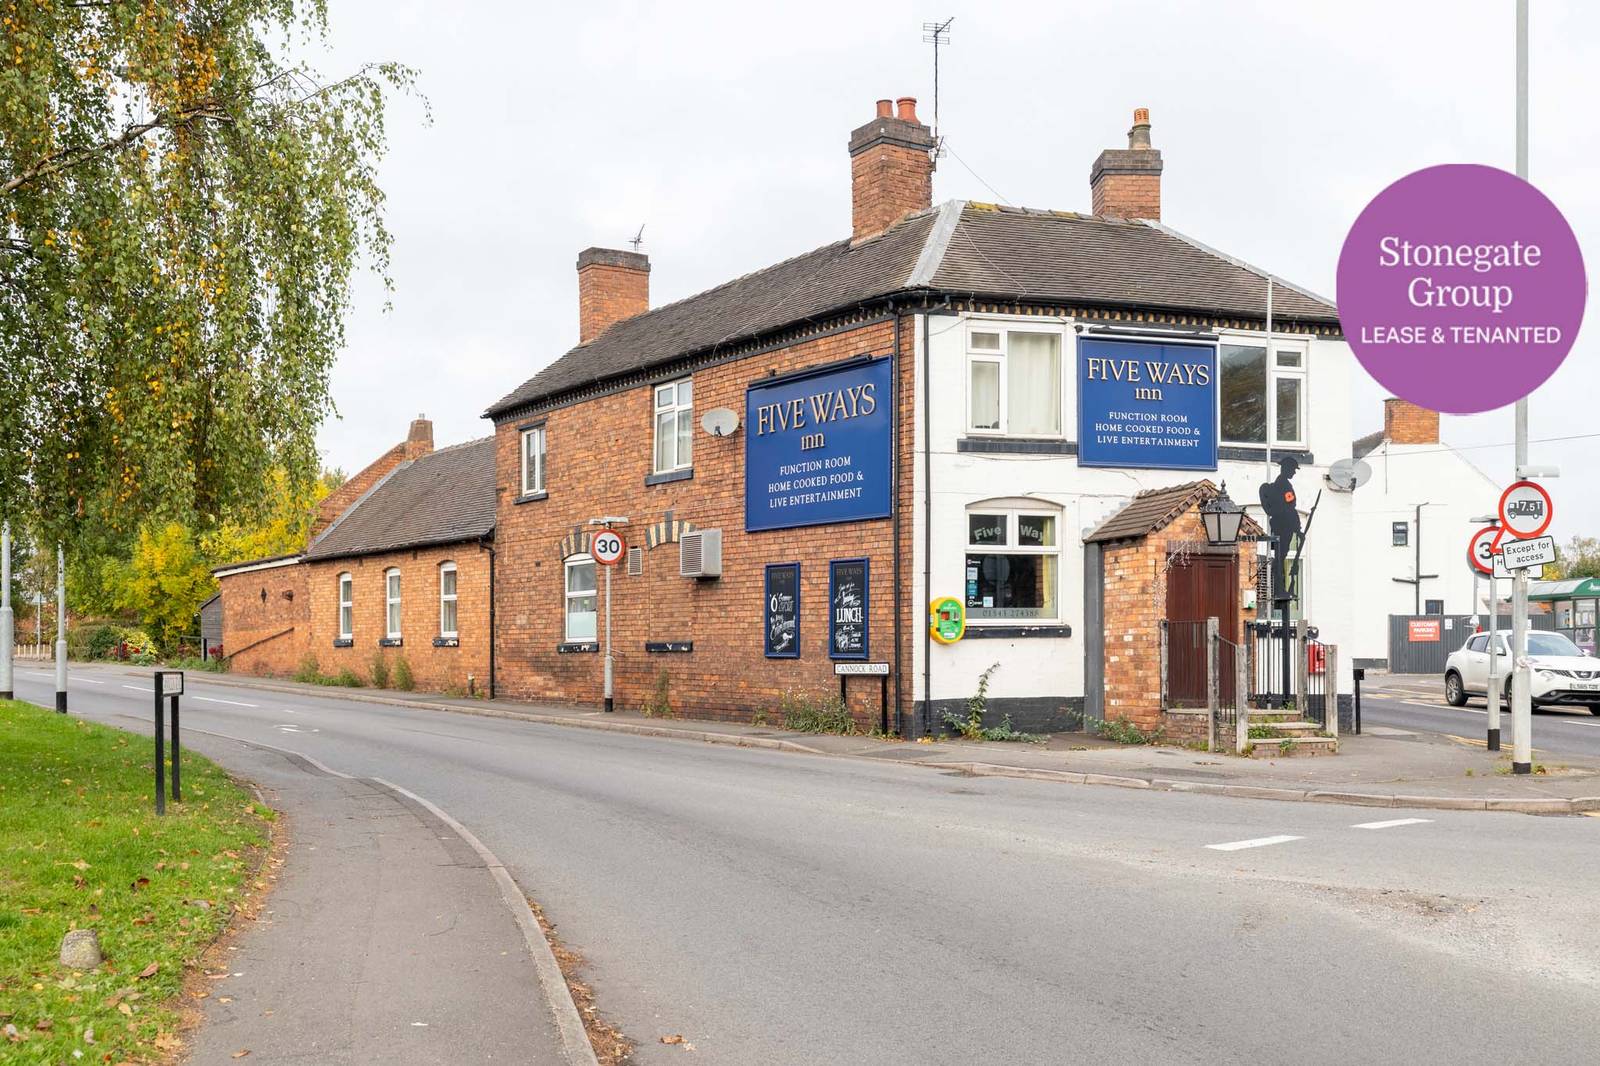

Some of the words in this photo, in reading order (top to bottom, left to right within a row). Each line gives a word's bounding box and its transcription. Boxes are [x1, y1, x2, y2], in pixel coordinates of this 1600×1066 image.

[1087, 357, 1141, 382] FIVE
[1145, 361, 1209, 386] WAYS
[1135, 387, 1163, 400] inn
[757, 398, 806, 435] FIVE
[809, 383, 876, 424] WAYS
[1109, 411, 1157, 422] FUNCTION
[1161, 414, 1188, 423] ROOM
[1095, 423, 1122, 432] HOME
[1125, 424, 1164, 434] COOKED
[1166, 426, 1191, 435] FOOD
[1194, 427, 1201, 435] &
[801, 432, 825, 450] inn
[1097, 435, 1118, 444] LIVE
[1122, 436, 1200, 447] ENTERTAINMENT
[780, 461, 822, 476] FUNCTION
[825, 456, 851, 469] ROOM
[768, 482, 791, 493] HOME
[793, 475, 827, 489] COOKED
[830, 471, 854, 485] FOOD
[857, 470, 864, 480] &
[769, 498, 787, 508] LIVE
[789, 487, 863, 506] ENTERTAINMENT
[1520, 501, 1541, 512] 7.5T
[974, 525, 1002, 541] Five
[598, 539, 620, 554] 30
[1479, 542, 1493, 559] 3
[1506, 543, 1535, 555] Except
[1538, 541, 1550, 550] for
[1516, 553, 1544, 563] access
[836, 607, 862, 623] LUNCH
[836, 664, 866, 673] CANNOCK
[868, 664, 888, 673] ROAD
